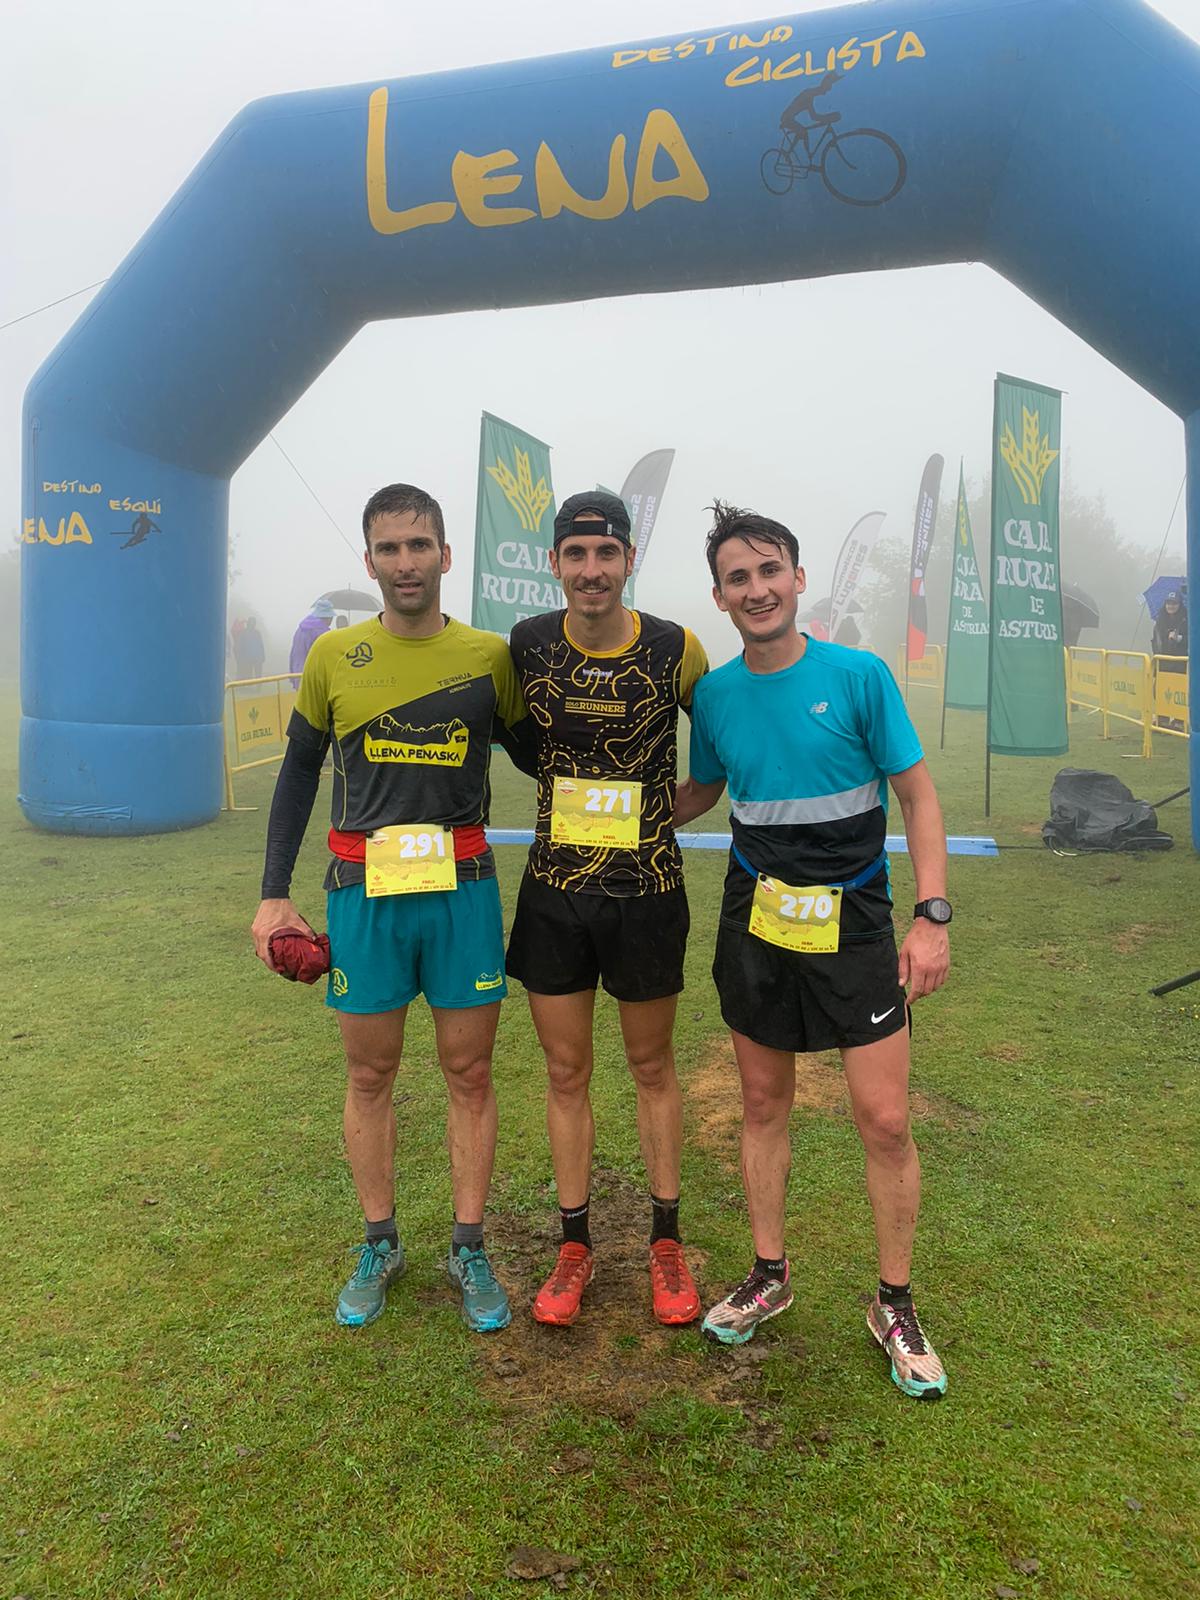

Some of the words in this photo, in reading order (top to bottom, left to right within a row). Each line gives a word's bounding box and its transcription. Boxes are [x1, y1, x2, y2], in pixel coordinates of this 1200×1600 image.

[612, 25, 793, 69] DESTINO
[724, 30, 926, 88] CICLISTA
[365, 86, 710, 235] LENA
[42, 480, 102, 494] DESTINO
[579, 701, 627, 713] RUNNERS
[584, 787, 632, 814] 271
[399, 831, 446, 859] 291
[779, 893, 833, 920] 270
